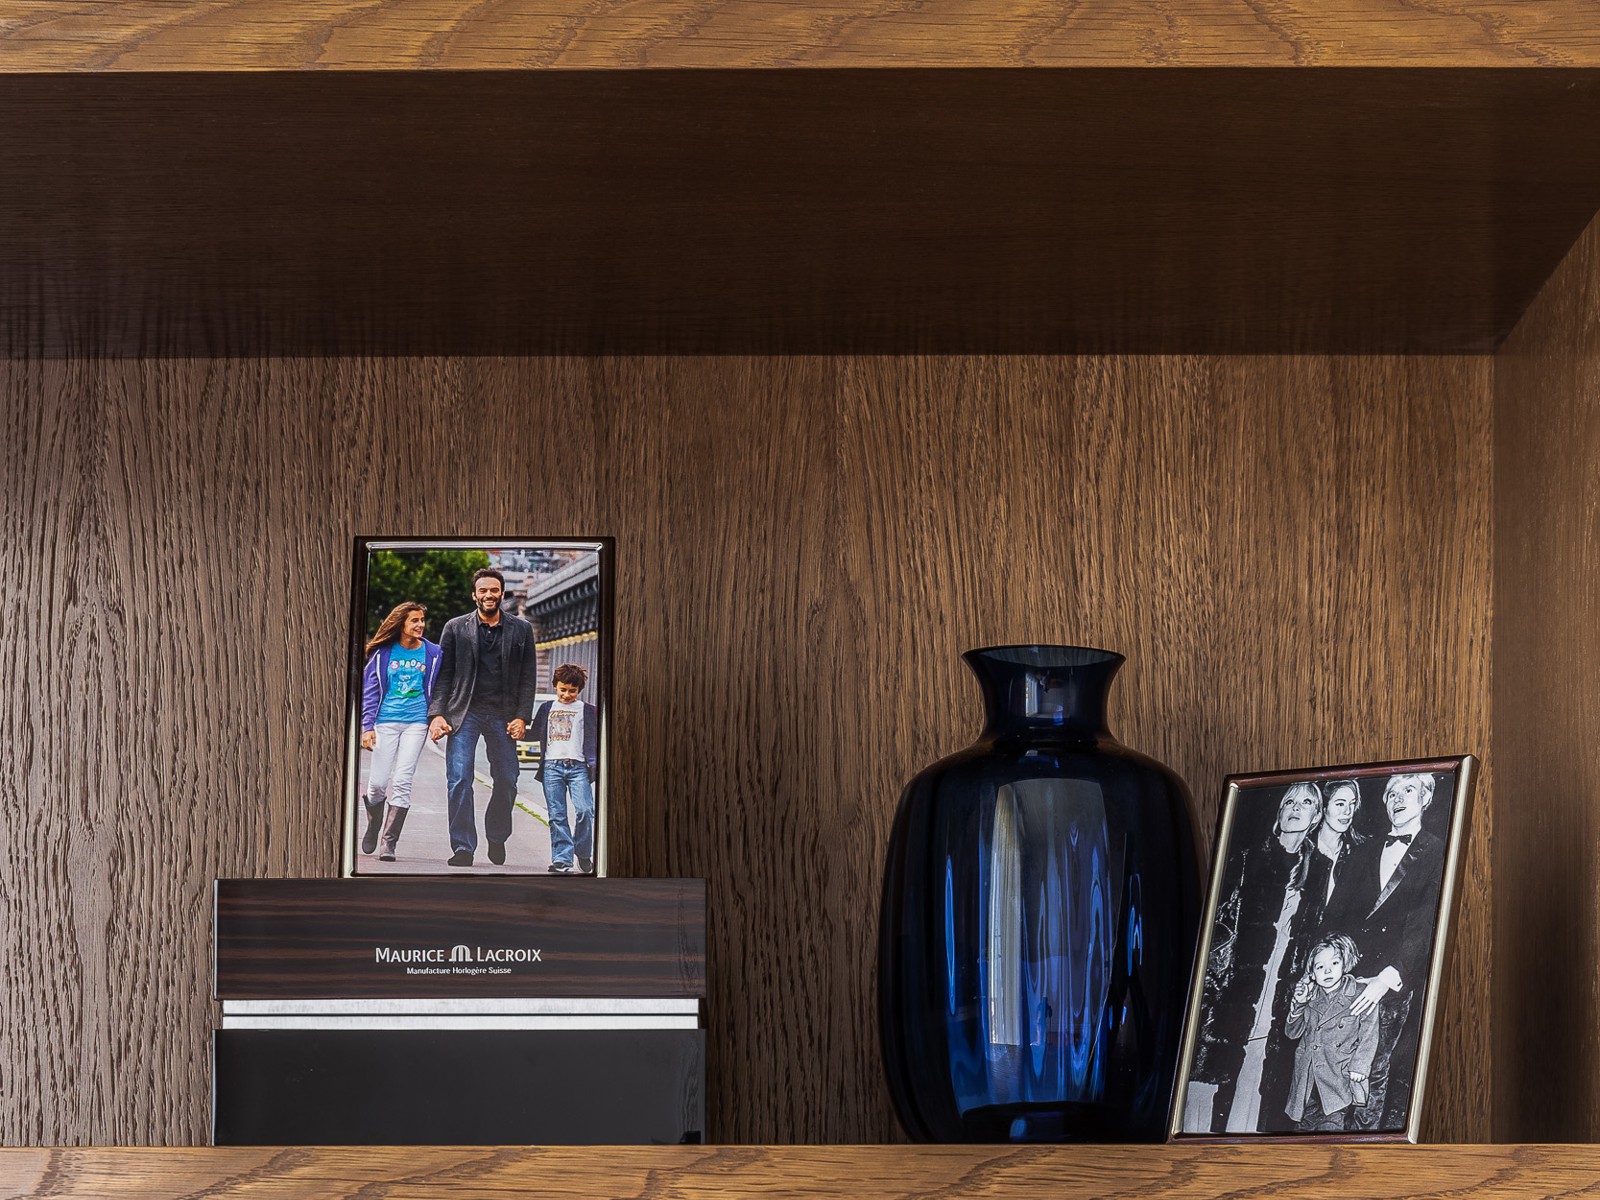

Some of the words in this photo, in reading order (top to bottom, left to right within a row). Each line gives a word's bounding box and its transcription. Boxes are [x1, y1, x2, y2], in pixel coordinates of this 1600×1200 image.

[375, 947, 445, 963] MAURICE
[477, 946, 542, 962] LACROIX
[406, 966, 451, 975] Manufacture
[452, 966, 487, 976] Horlogère
[488, 966, 512, 975] Suisse
